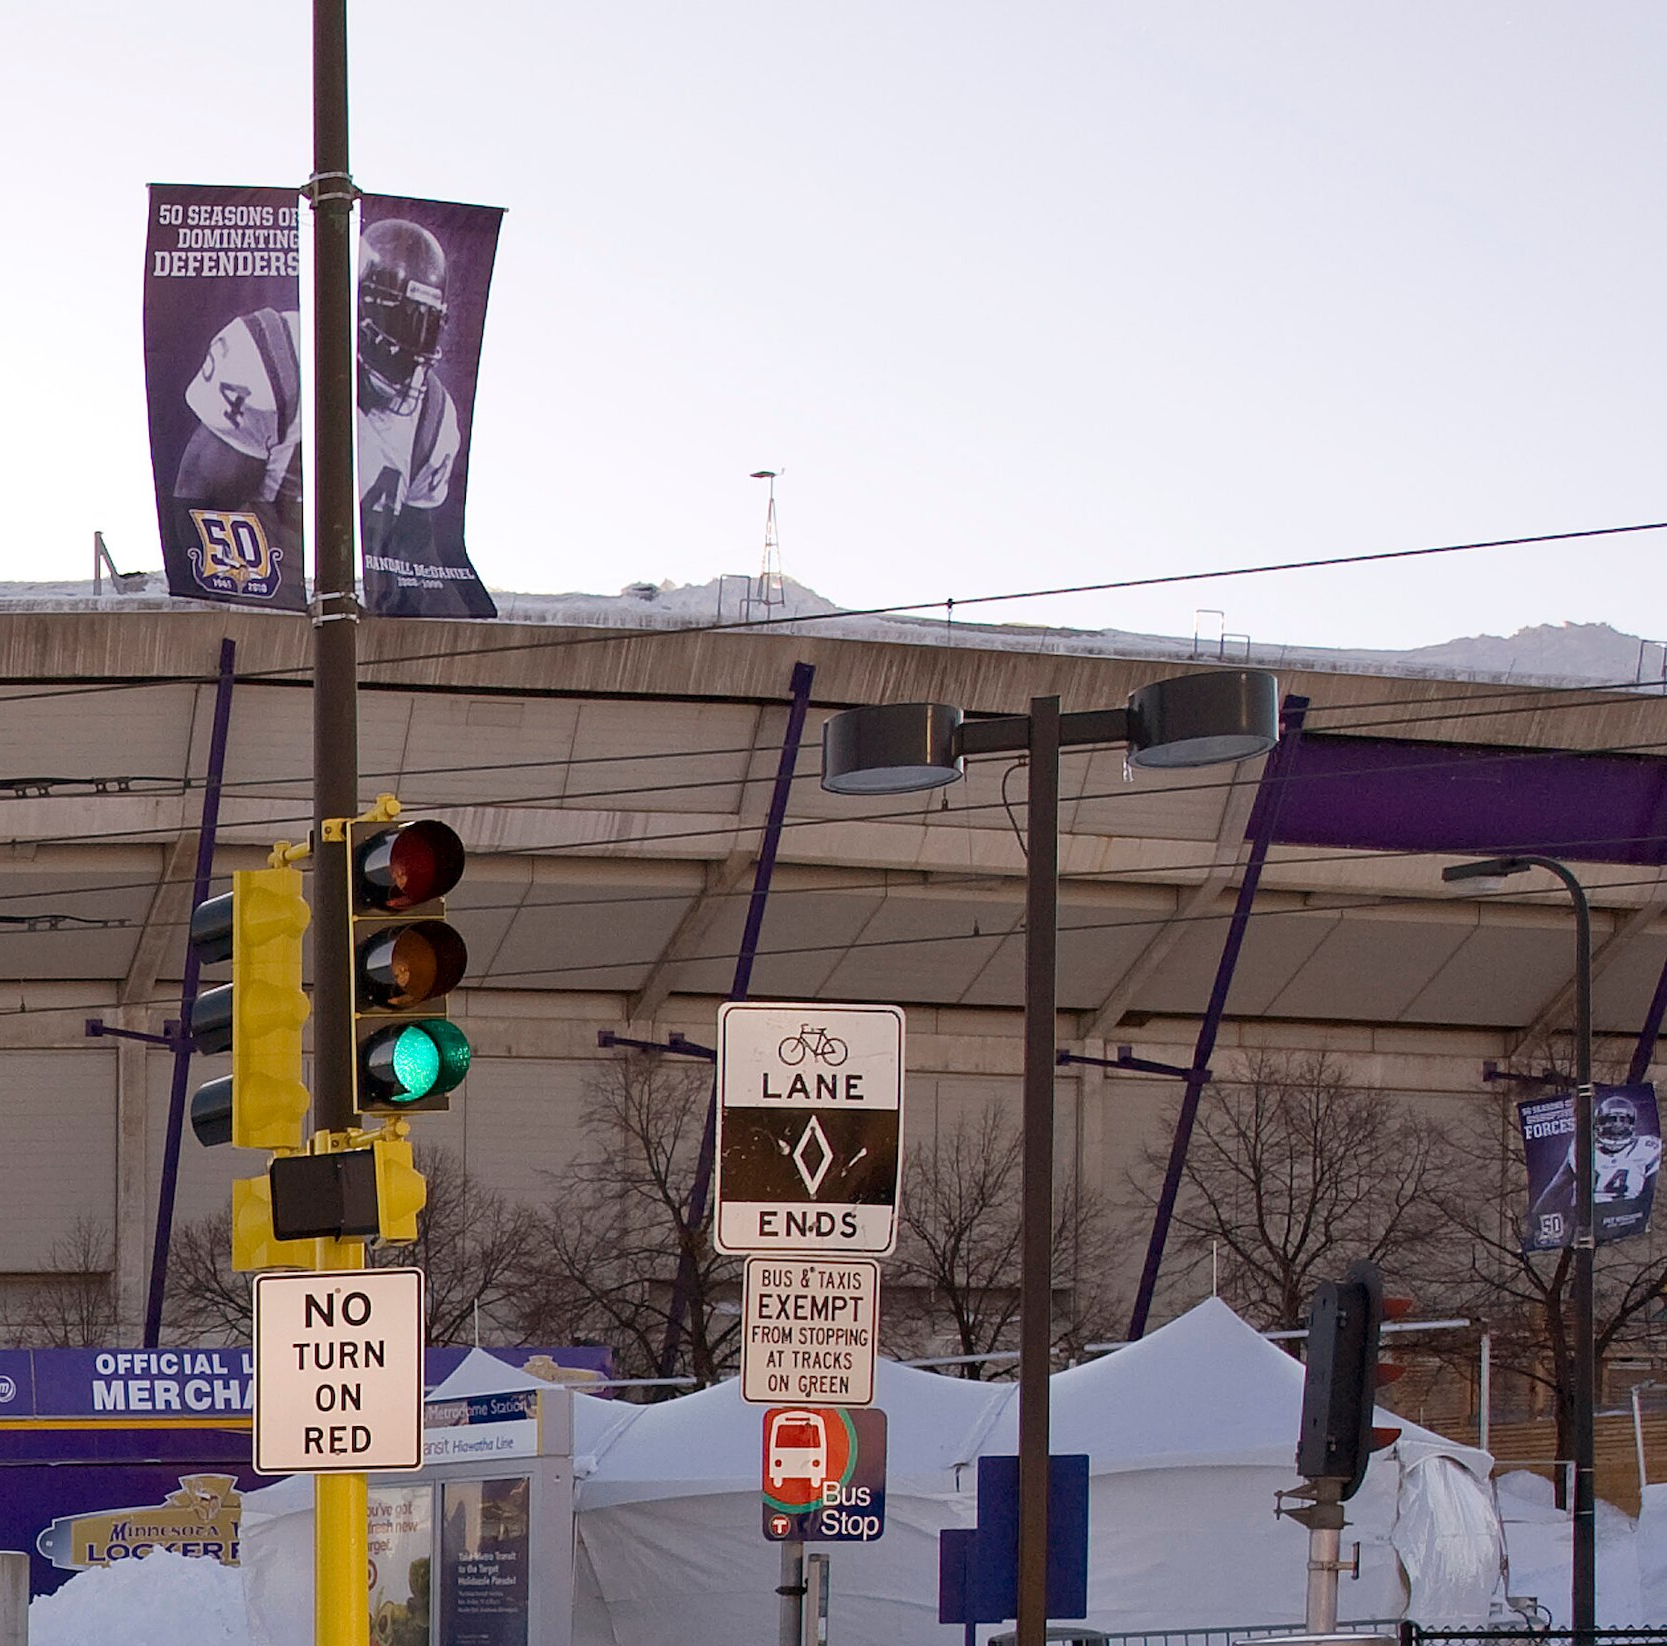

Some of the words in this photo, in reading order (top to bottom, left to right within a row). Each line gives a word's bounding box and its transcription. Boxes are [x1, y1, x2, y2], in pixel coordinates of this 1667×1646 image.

[159, 204, 183, 225] 50
[187, 205, 273, 226] SEASONS
[177, 228, 299, 249] DOMINATING
[153, 251, 300, 277] DEFENDERS
[201, 518, 263, 568] 50
[365, 554, 413, 576] RANDALL
[762, 1073, 864, 1100] LANE
[1524, 1118, 1576, 1140] FORCES
[759, 1211, 857, 1238] ENDS
[762, 1269, 793, 1288] BUS
[800, 1269, 810, 1288] &
[818, 1271, 862, 1290] TAXIS
[304, 1292, 372, 1328] NO
[758, 1293, 864, 1322] EXEMPT
[752, 1325, 793, 1344] FROM
[798, 1327, 868, 1347] STOPPING
[95, 1352, 229, 1376] OFFICIAL
[292, 1340, 385, 1370] TURN
[766, 1350, 784, 1368] AT
[792, 1351, 853, 1370] TRACKS
[768, 1374, 789, 1392] ON
[798, 1375, 849, 1395] GREEN
[315, 1383, 361, 1412] ON
[490, 1398, 527, 1415] Station
[304, 1425, 372, 1454] RED
[495, 1436, 514, 1450] Line
[822, 1480, 871, 1507] Bus
[367, 1503, 393, 1518] ou've
[820, 1509, 880, 1541] Stop
